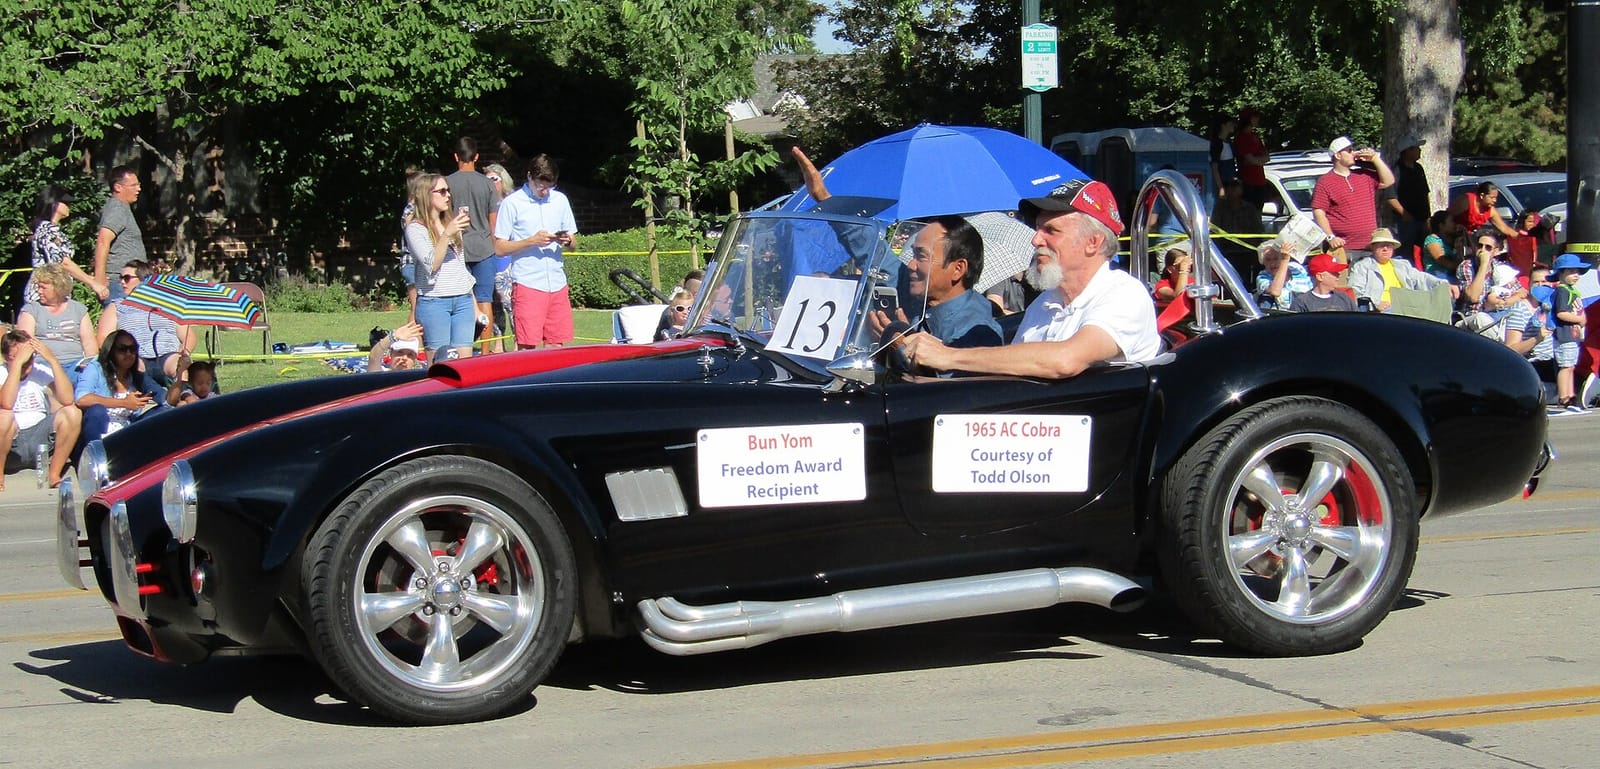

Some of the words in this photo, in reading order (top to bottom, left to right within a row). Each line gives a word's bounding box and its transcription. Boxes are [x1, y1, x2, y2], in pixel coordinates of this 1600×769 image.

[1027, 42, 1034, 52] 2
[781, 298, 837, 353] 13
[965, 422, 996, 437] 1965
[1000, 422, 1018, 437] AC
[1021, 421, 1061, 437] Cobra
[748, 435, 777, 450] Bun
[780, 433, 813, 449] Yom
[970, 448, 1034, 464] Courtesy
[1038, 448, 1053, 462] of
[721, 461, 789, 477] Freedom
[794, 457, 843, 474] Award
[971, 470, 1006, 483] Todd
[1010, 470, 1051, 483] Olson
[747, 483, 819, 500] Recipient
